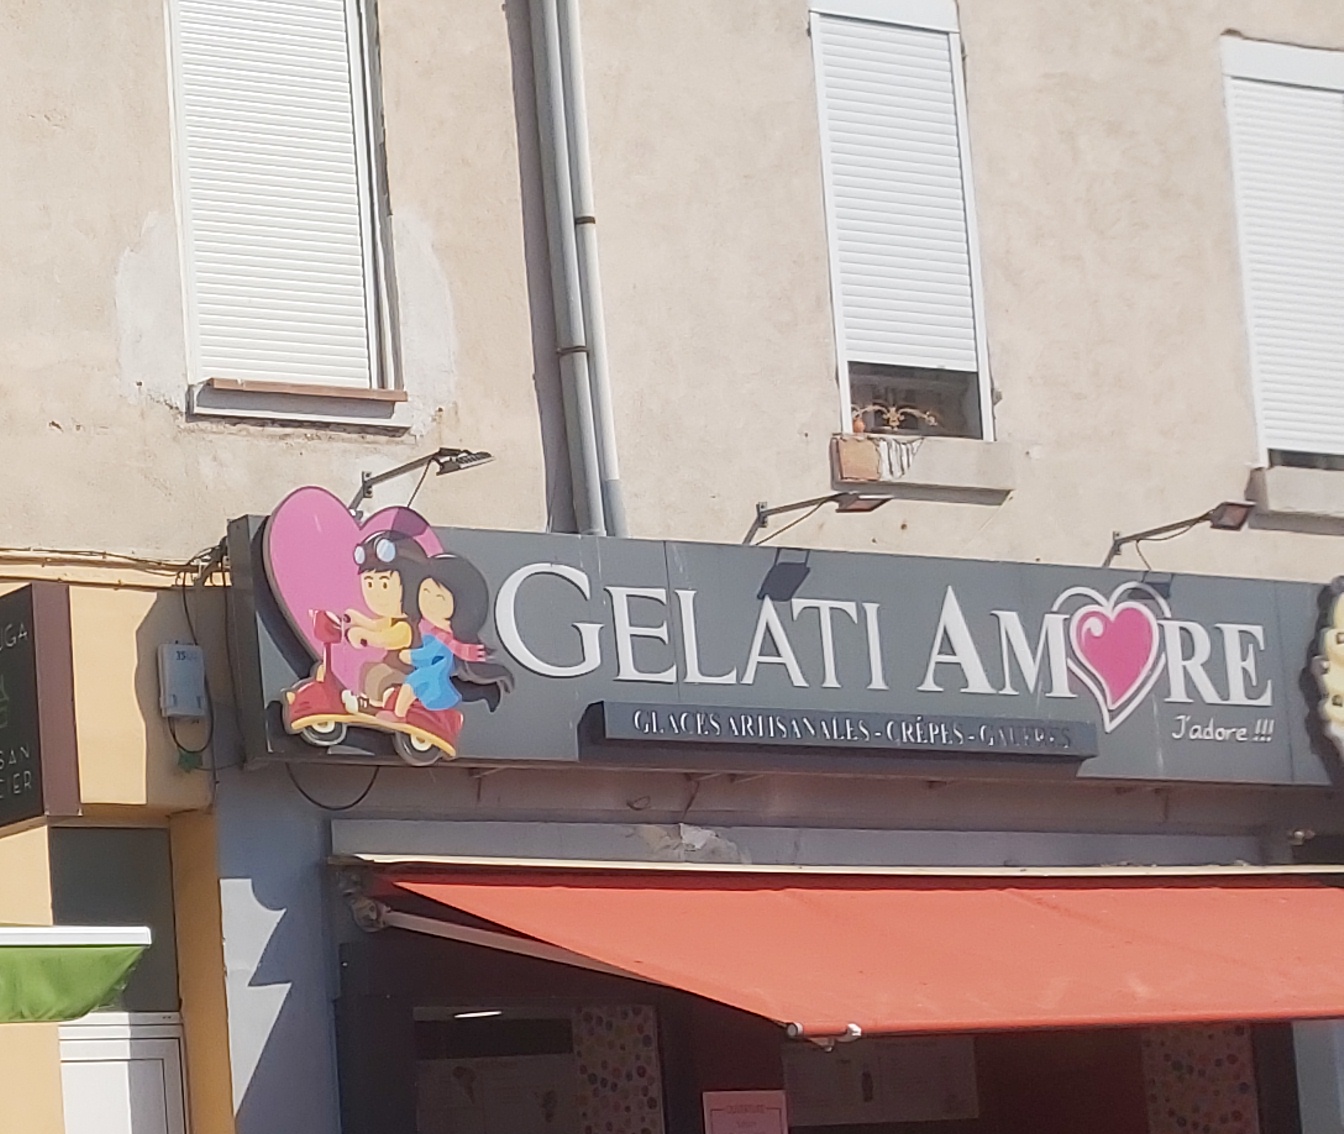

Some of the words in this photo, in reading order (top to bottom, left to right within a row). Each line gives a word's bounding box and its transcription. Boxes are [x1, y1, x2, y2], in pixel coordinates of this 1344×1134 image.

[493, 562, 891, 691] GELATI
[633, 707, 721, 737] GLACES
[727, 712, 872, 743] ARTISANALES
[1171, 715, 1248, 742] J'adore
